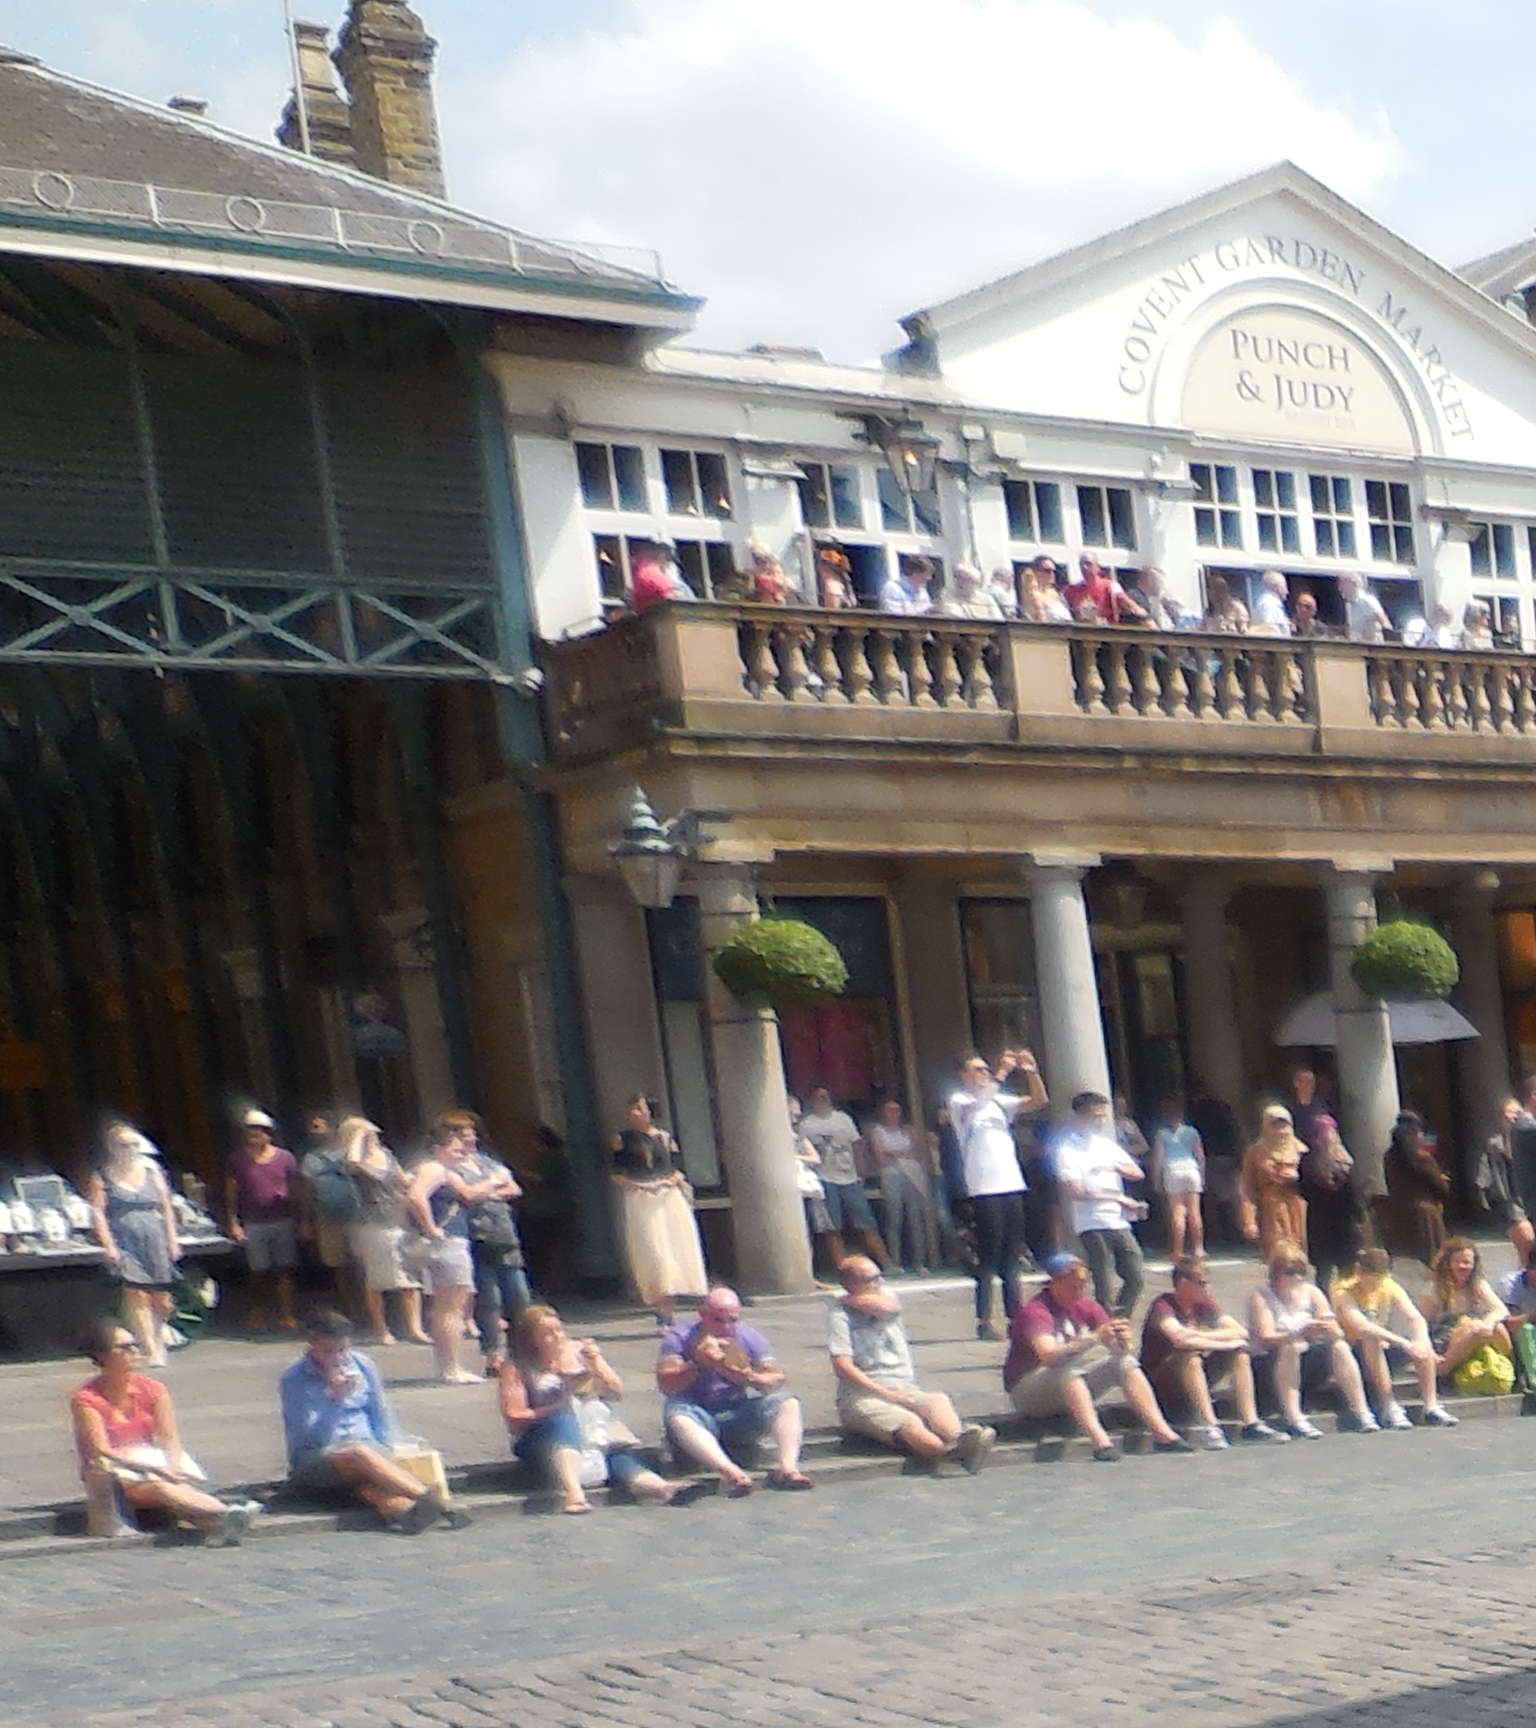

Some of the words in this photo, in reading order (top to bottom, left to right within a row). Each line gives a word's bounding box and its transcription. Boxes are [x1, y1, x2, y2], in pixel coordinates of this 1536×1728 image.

[1118, 256, 1207, 396] COVENT
[1215, 235, 1366, 296] GARDEN
[1376, 291, 1475, 441] MARKET
[1230, 328, 1350, 373] PUNCH
[1235, 371, 1263, 402] &
[1275, 373, 1355, 413] JUDY
